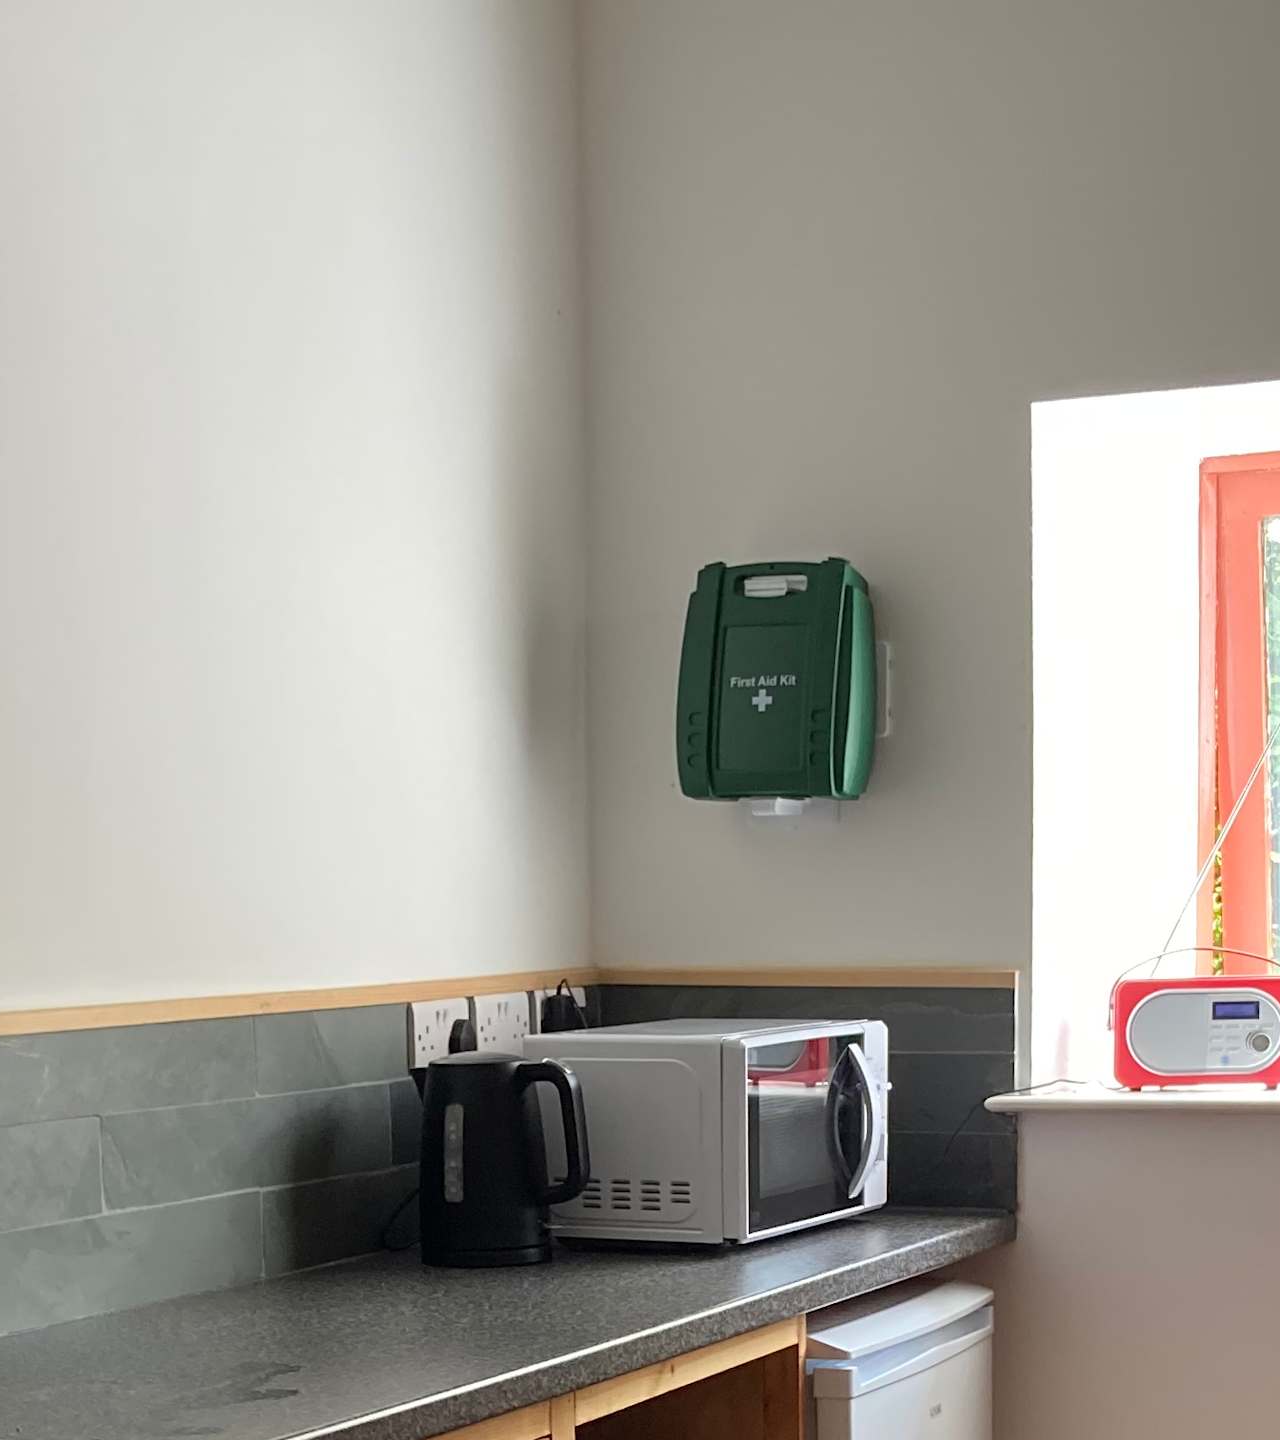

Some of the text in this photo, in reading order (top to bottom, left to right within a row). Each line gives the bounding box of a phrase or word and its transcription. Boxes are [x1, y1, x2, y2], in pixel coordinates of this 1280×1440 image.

[730, 674, 797, 688] First Aid Kit
